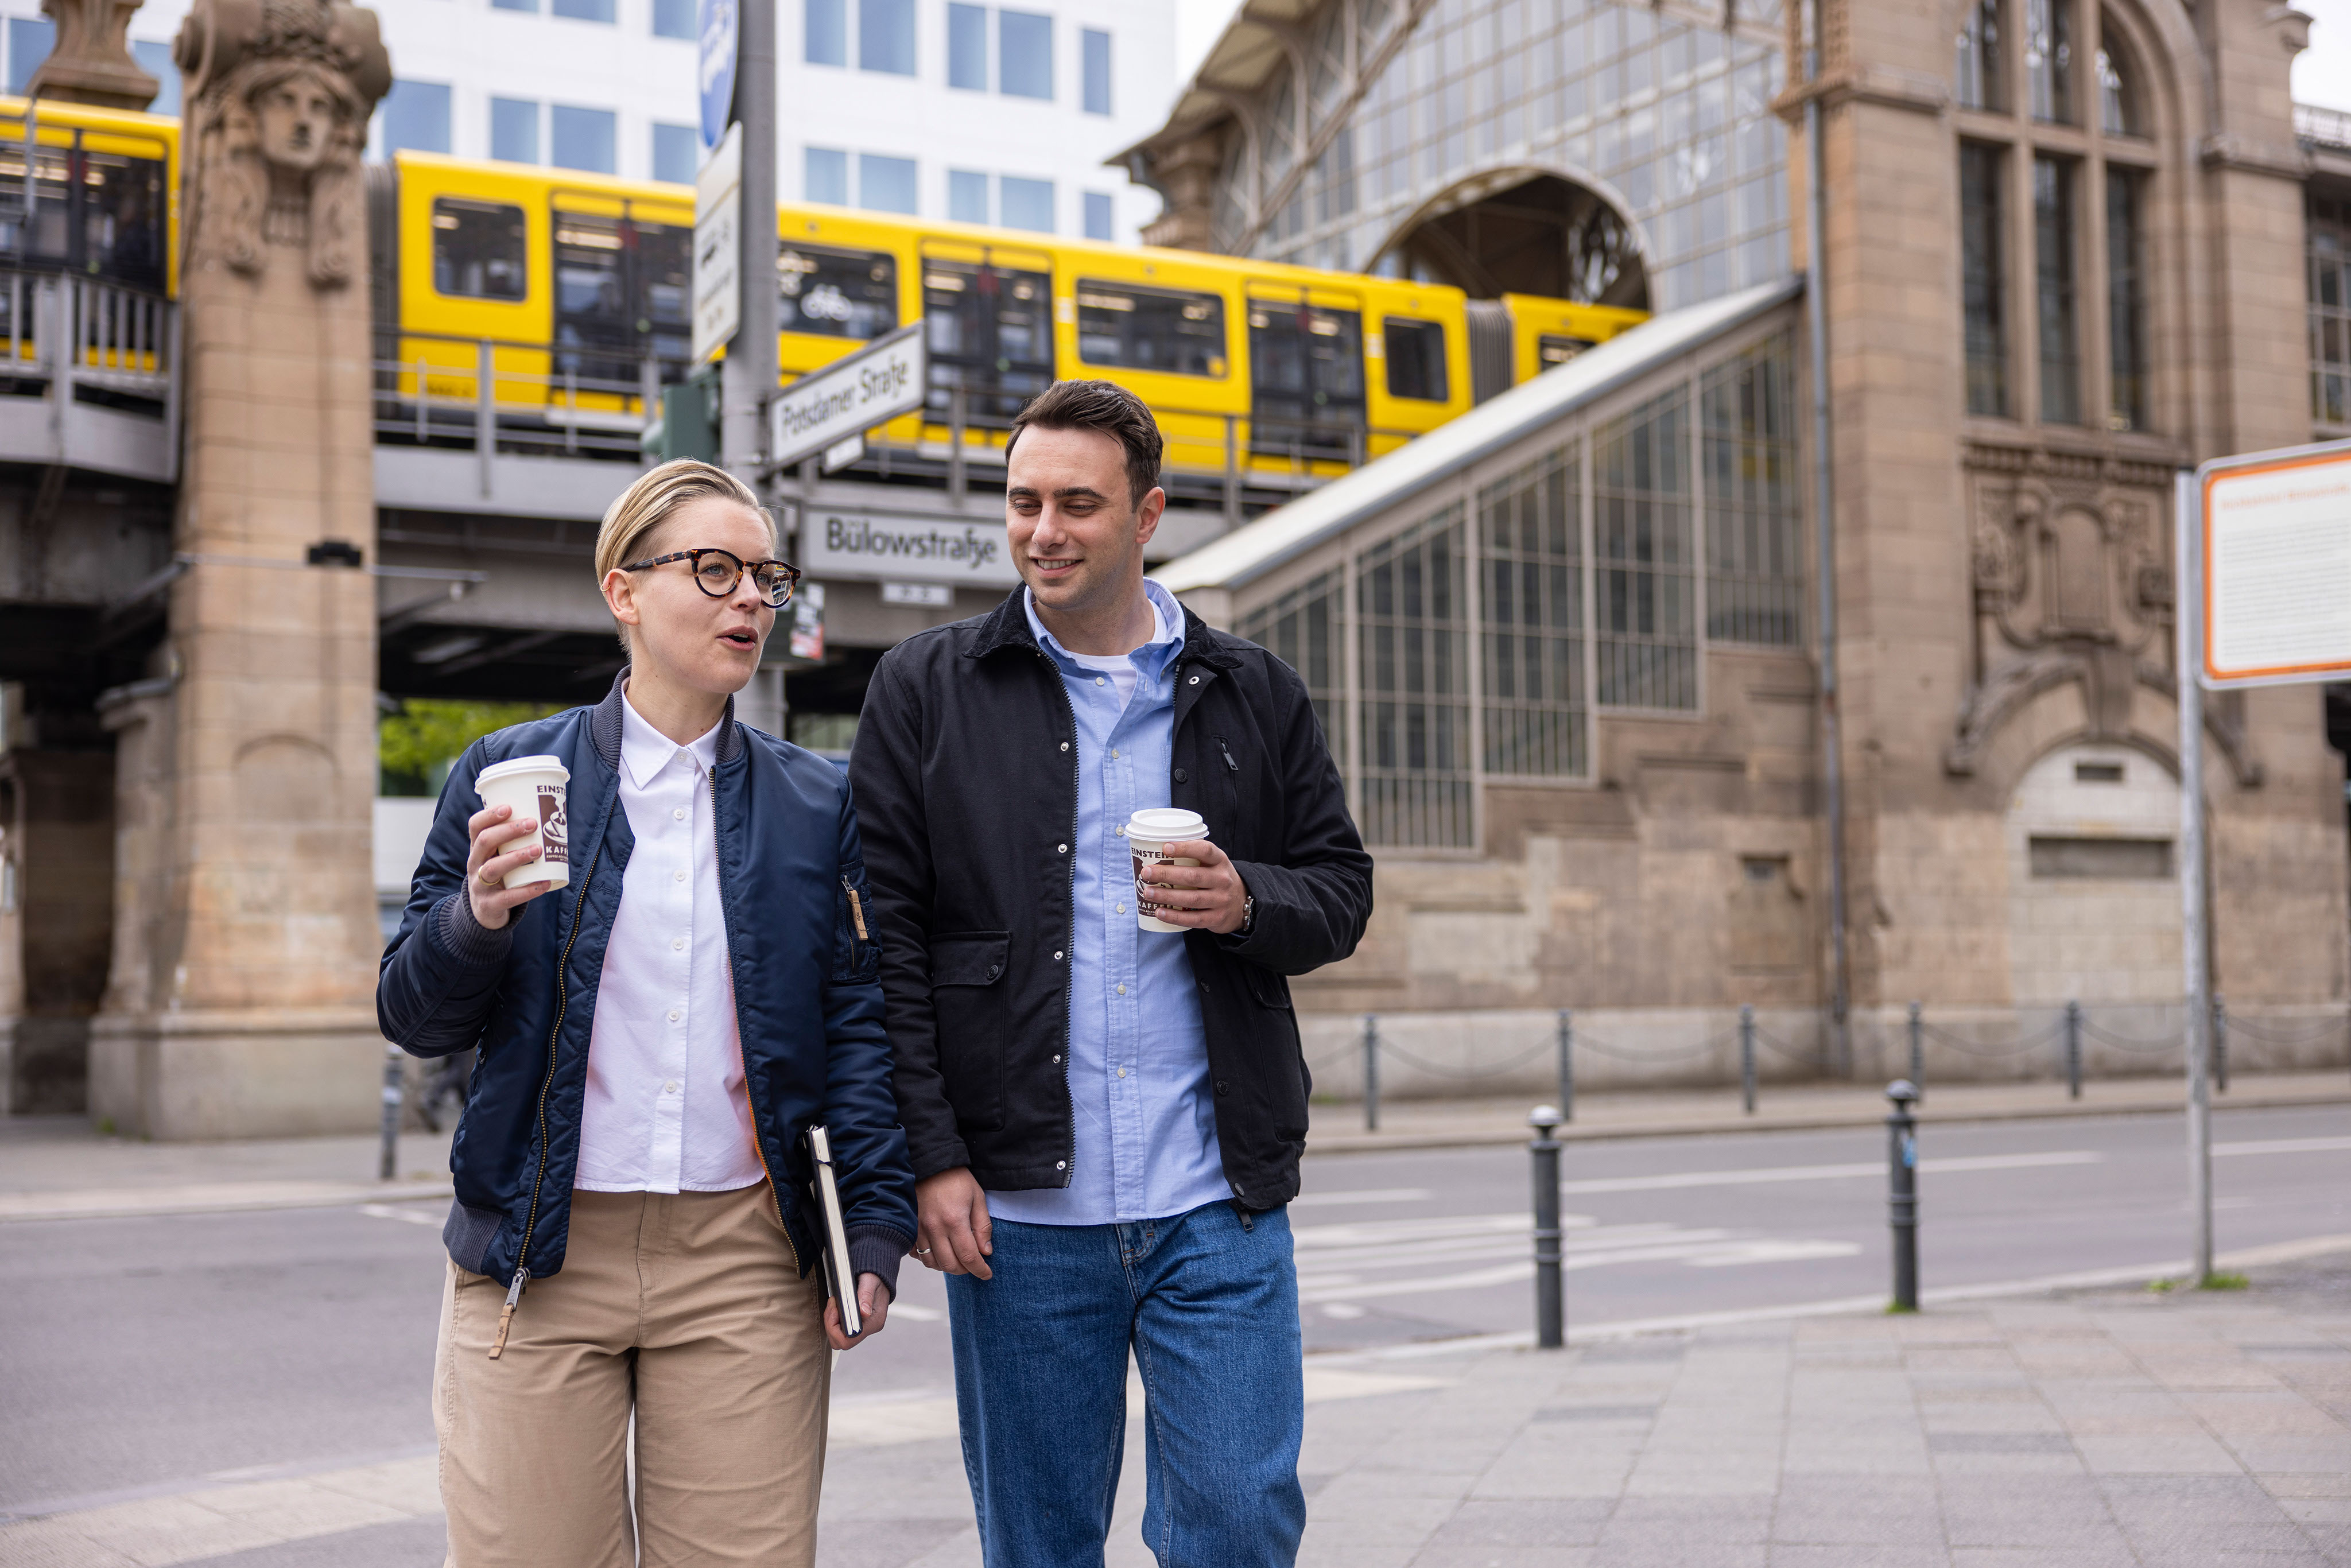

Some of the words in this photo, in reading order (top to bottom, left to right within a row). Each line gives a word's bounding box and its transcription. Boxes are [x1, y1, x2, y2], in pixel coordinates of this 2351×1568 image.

[860, 354, 907, 403] Straße
[826, 517, 997, 570] Bülowstraße
[1131, 847, 1174, 859] EINSTEI
